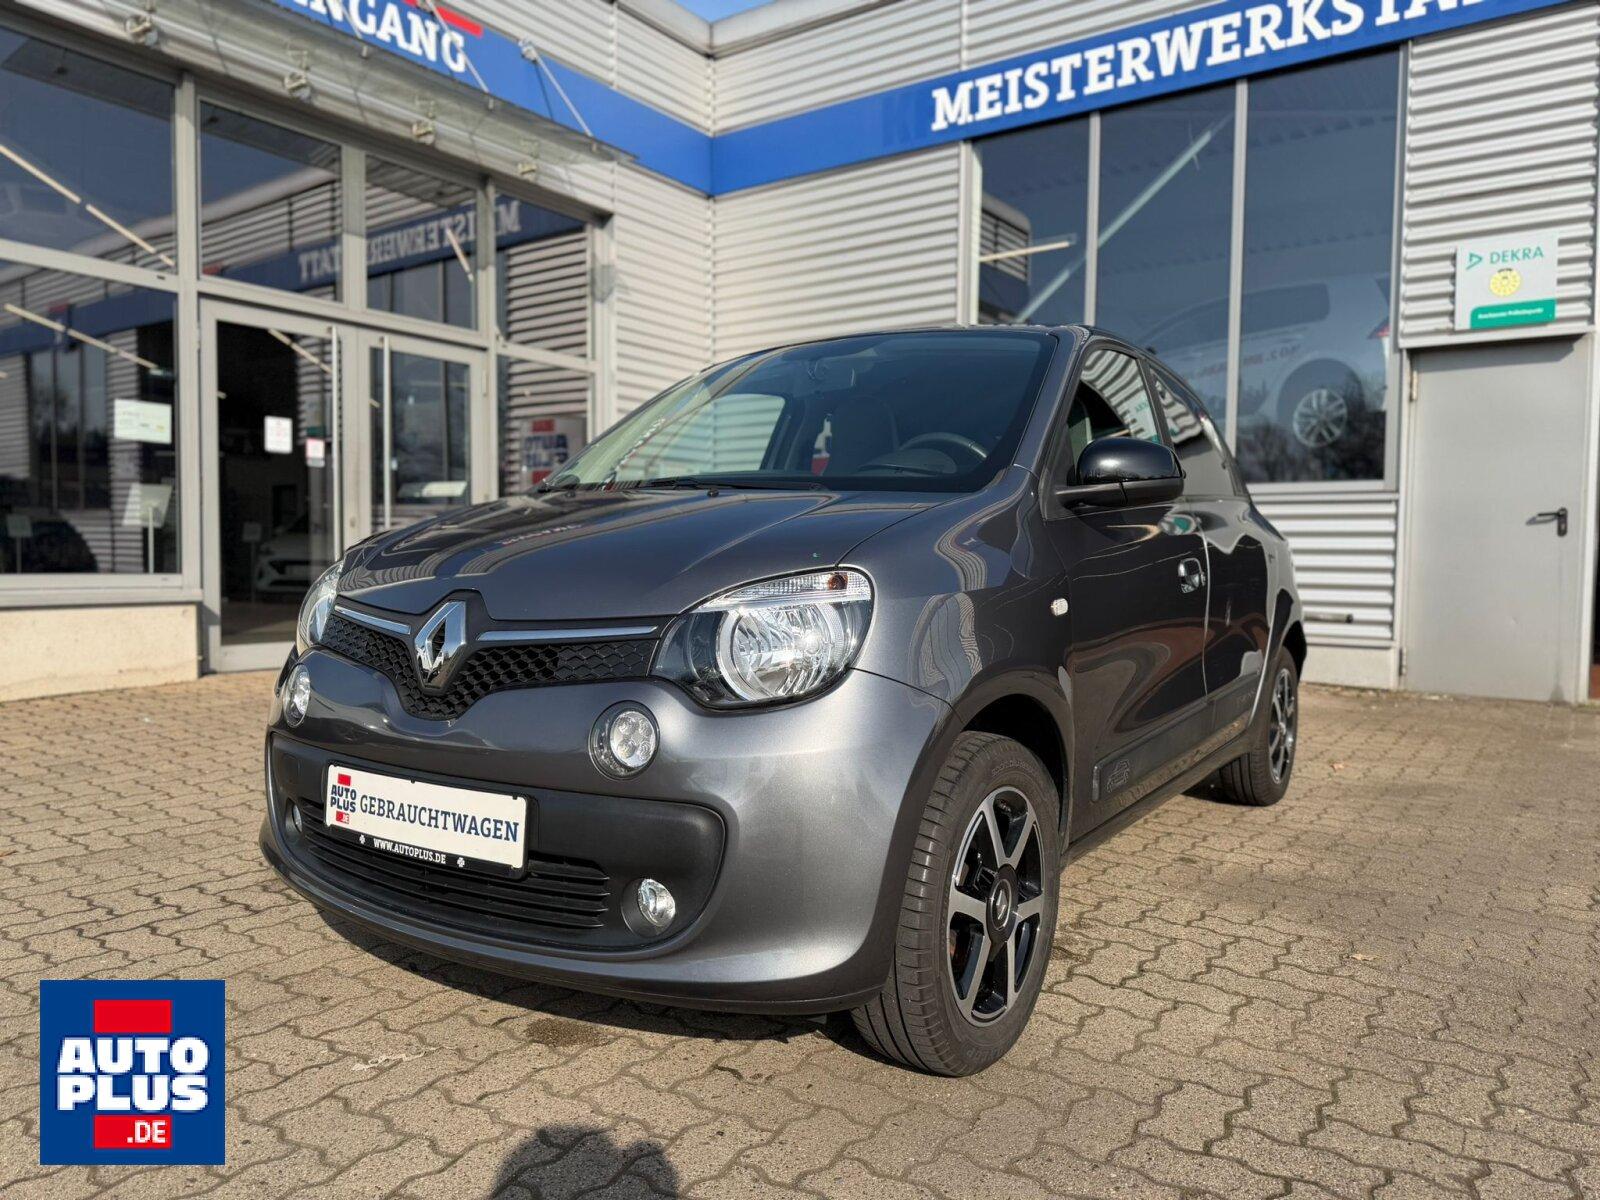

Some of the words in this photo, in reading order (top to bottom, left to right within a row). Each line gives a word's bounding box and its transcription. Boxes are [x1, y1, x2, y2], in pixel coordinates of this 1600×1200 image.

[294, 0, 465, 72] NGANG
[931, 0, 1484, 132] MEISTERWERKST
[1490, 246, 1544, 264] DEKRA
[330, 796, 357, 812] PLUS
[331, 785, 357, 800] AUTO
[360, 794, 520, 842] GEBRAUCHTWAGEN
[373, 838, 446, 864] WWW.AUTOPLUS.DE
